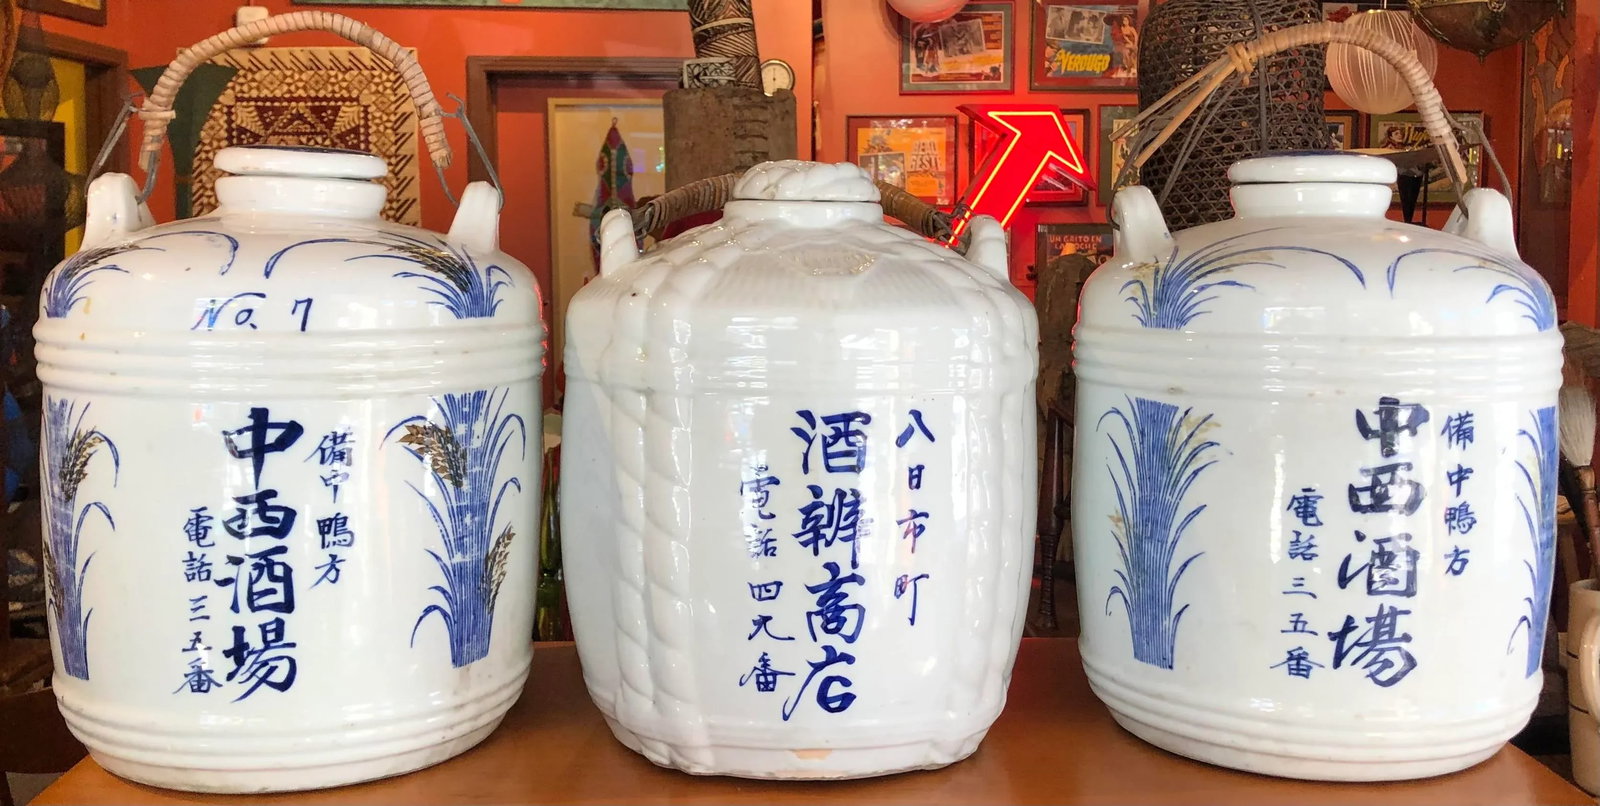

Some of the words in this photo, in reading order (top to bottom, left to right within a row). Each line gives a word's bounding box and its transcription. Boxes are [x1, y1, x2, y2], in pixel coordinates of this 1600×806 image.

[1059, 48, 1111, 74] VERDUGO
[291, 298, 314, 332] 7
[1049, 234, 1061, 243] UN
[1063, 235, 1090, 243] GRITO
[1091, 235, 1102, 243] EN
[213, 407, 305, 704] 中西酒場
[303, 427, 356, 591] 備中鴨方
[894, 409, 936, 627] 八日市町
[1440, 410, 1477, 577] 備中鴨方
[1269, 487, 1326, 680] 電話三五番
